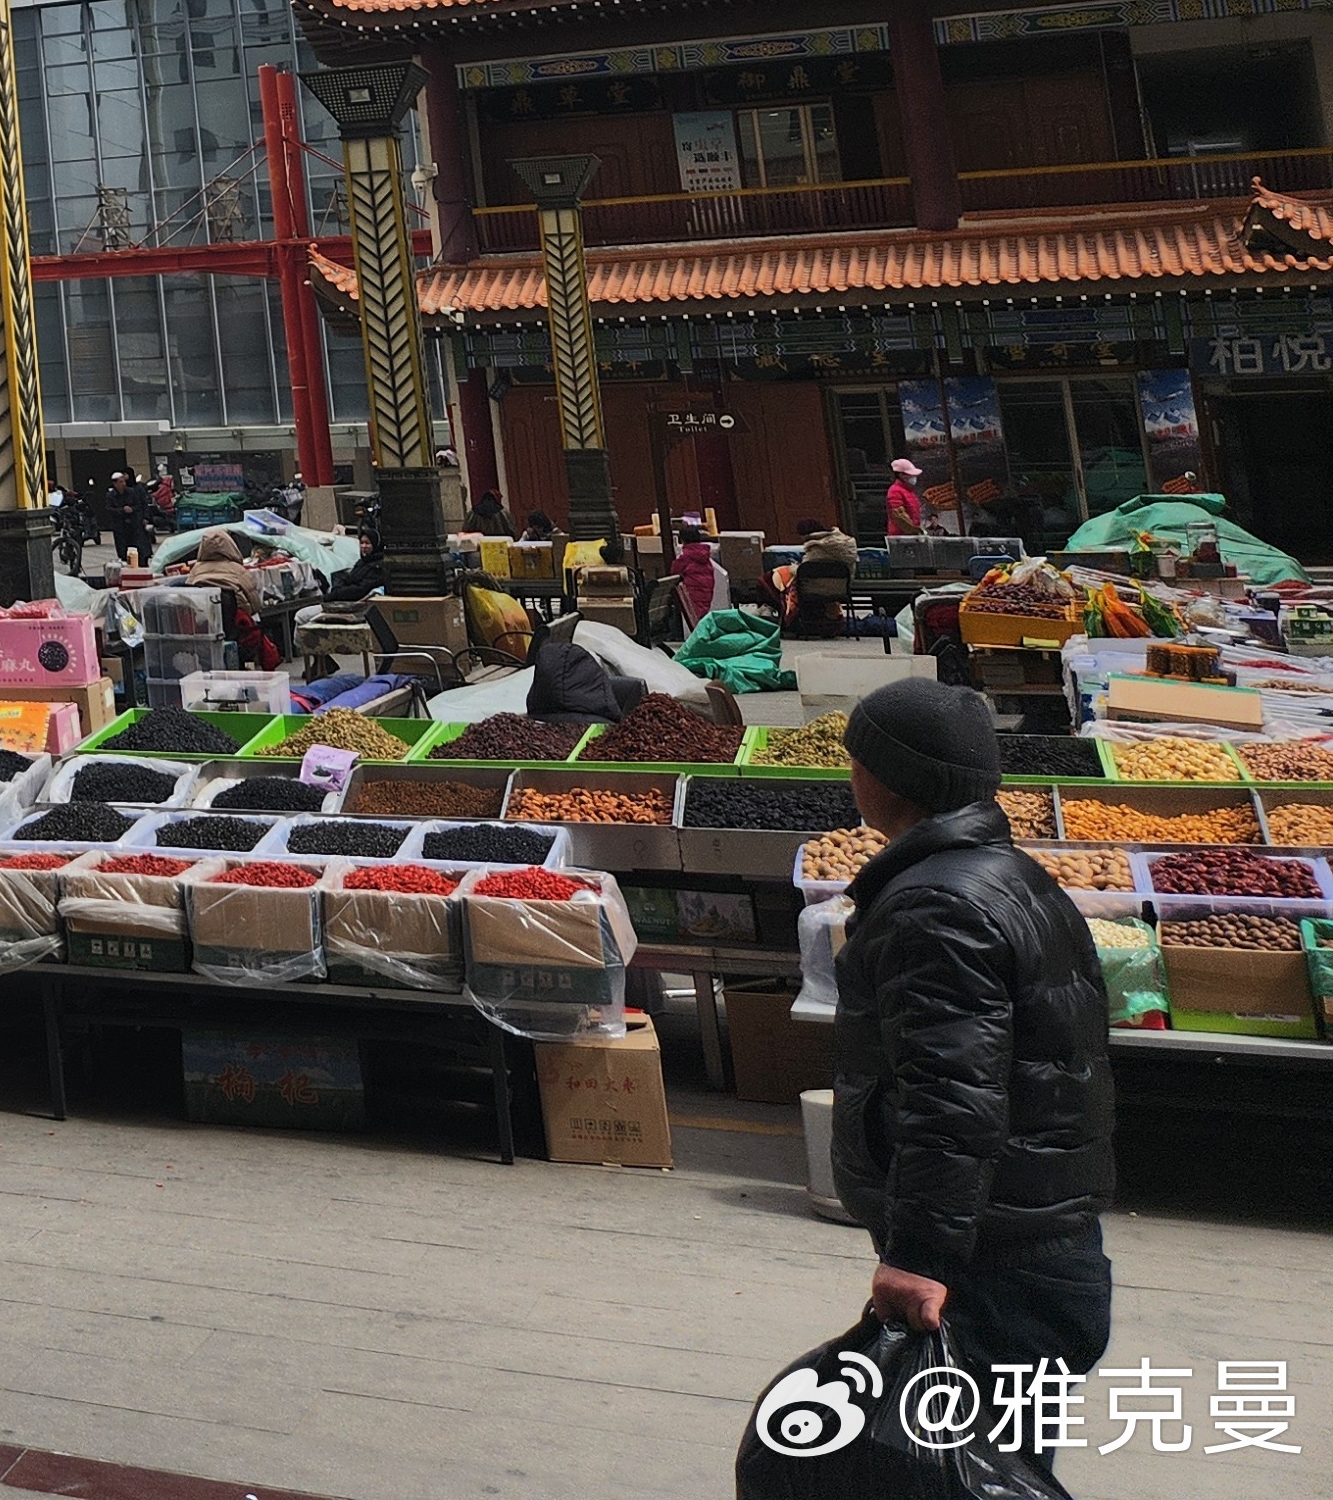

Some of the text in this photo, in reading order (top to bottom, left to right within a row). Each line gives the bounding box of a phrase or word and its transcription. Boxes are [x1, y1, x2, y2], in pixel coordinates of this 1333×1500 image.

[1209, 333, 1333, 376] 柏悦
[666, 412, 717, 426] 卫生间
[217, 1063, 320, 1107] 枸杞
